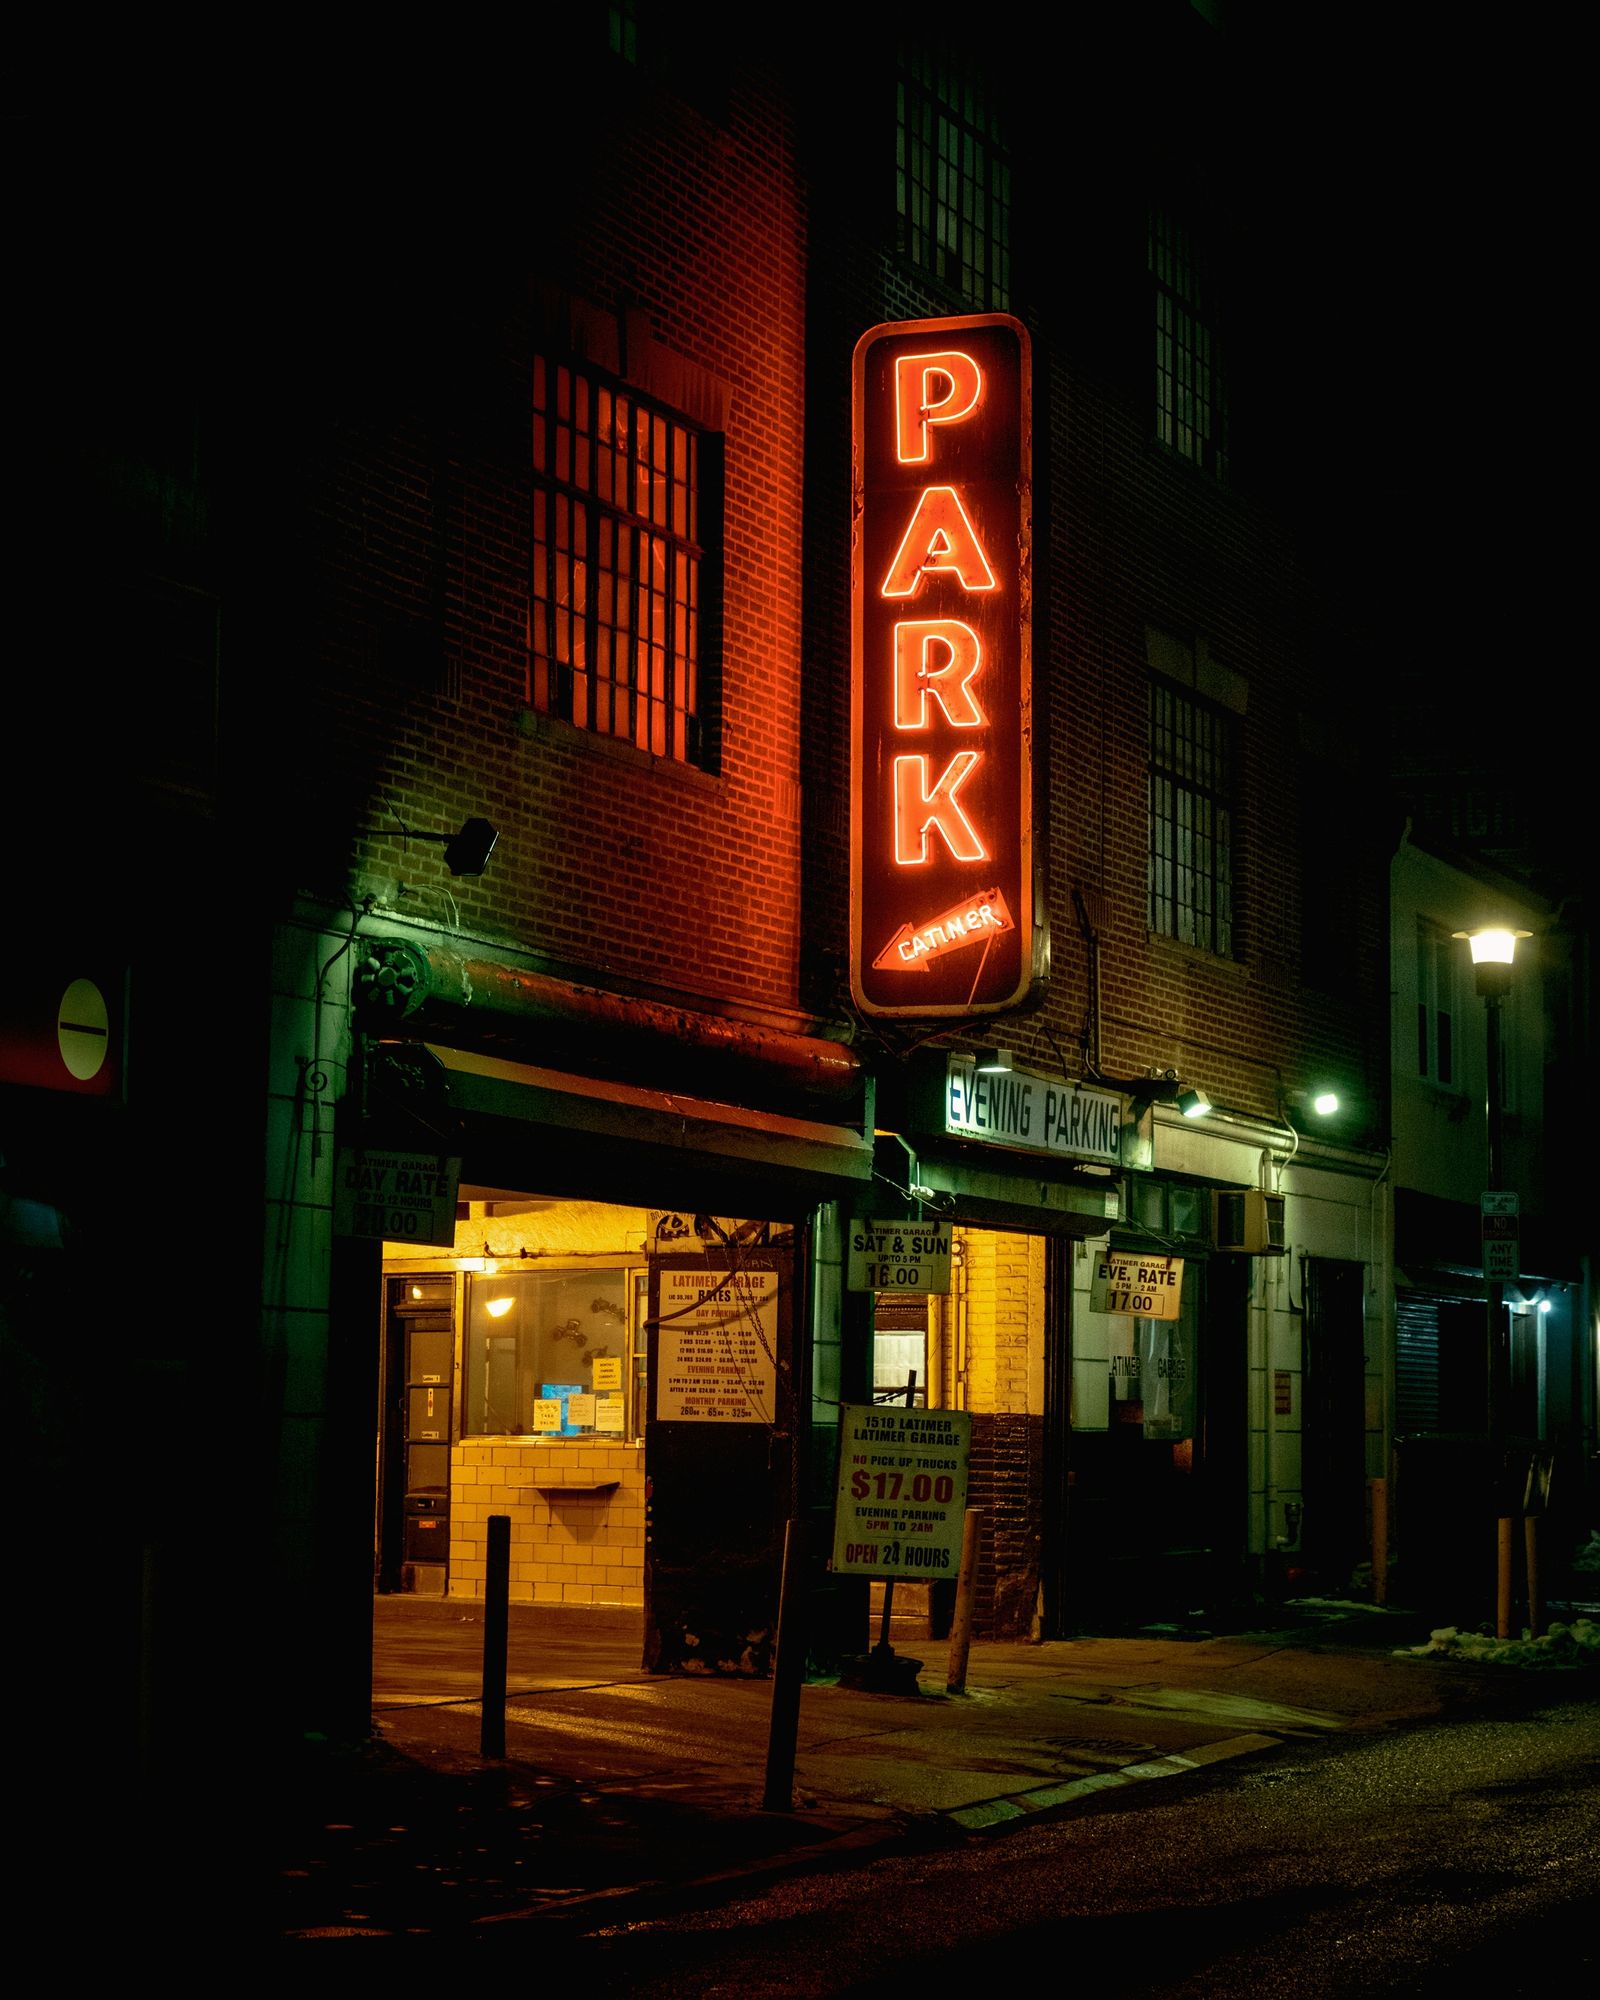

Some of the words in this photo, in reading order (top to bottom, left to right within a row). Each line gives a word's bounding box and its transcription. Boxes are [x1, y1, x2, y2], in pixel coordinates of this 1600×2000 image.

[880, 350, 997, 866] PARK
[949, 1068, 1032, 1137] EVENING
[1044, 1089, 1121, 1154] PARKING
[356, 1157, 399, 1169] ATIMER
[345, 1166, 387, 1190] DAY
[395, 1171, 449, 1198] RATE
[1493, 1216, 1508, 1229] NO
[853, 1234, 887, 1252] SAT
[893, 1236, 904, 1253] &
[912, 1237, 948, 1255] SUN
[1489, 1244, 1513, 1255] ANY
[891, 1255, 901, 1263] TO
[1488, 1256, 1513, 1267] TIME
[672, 1275, 718, 1288] LATIMER
[868, 1264, 919, 1287] 16.00
[1098, 1264, 1131, 1281] EVE.
[1138, 1268, 1176, 1286] RATE
[1110, 1291, 1152, 1311] 17.00
[696, 1309, 709, 1317] DAY
[711, 1309, 740, 1318] PARKING
[687, 1365, 715, 1374] EVENING
[717, 1366, 746, 1375] PARKING
[1108, 1355, 1141, 1377] ATIMER
[685, 1396, 716, 1406] MONTHLY
[718, 1397, 747, 1407] PARKING
[900, 1418, 952, 1432] LATIMER
[854, 1429, 905, 1443] LATIMER
[911, 1432, 960, 1446] GARAGE
[853, 1455, 867, 1465] NO
[871, 1455, 895, 1467] PICK
[899, 1457, 912, 1467] UP
[917, 1458, 957, 1470] TRUCKS
[851, 1469, 954, 1503] $17.00
[856, 1507, 898, 1519] EVENING
[901, 1510, 946, 1521] PARKING
[866, 1520, 889, 1531] 5PM
[893, 1521, 906, 1531] TO
[910, 1522, 934, 1533] 2AM
[846, 1543, 878, 1564] OPEN
[882, 1542, 901, 1565] 24
[904, 1546, 950, 1568] HOURS
